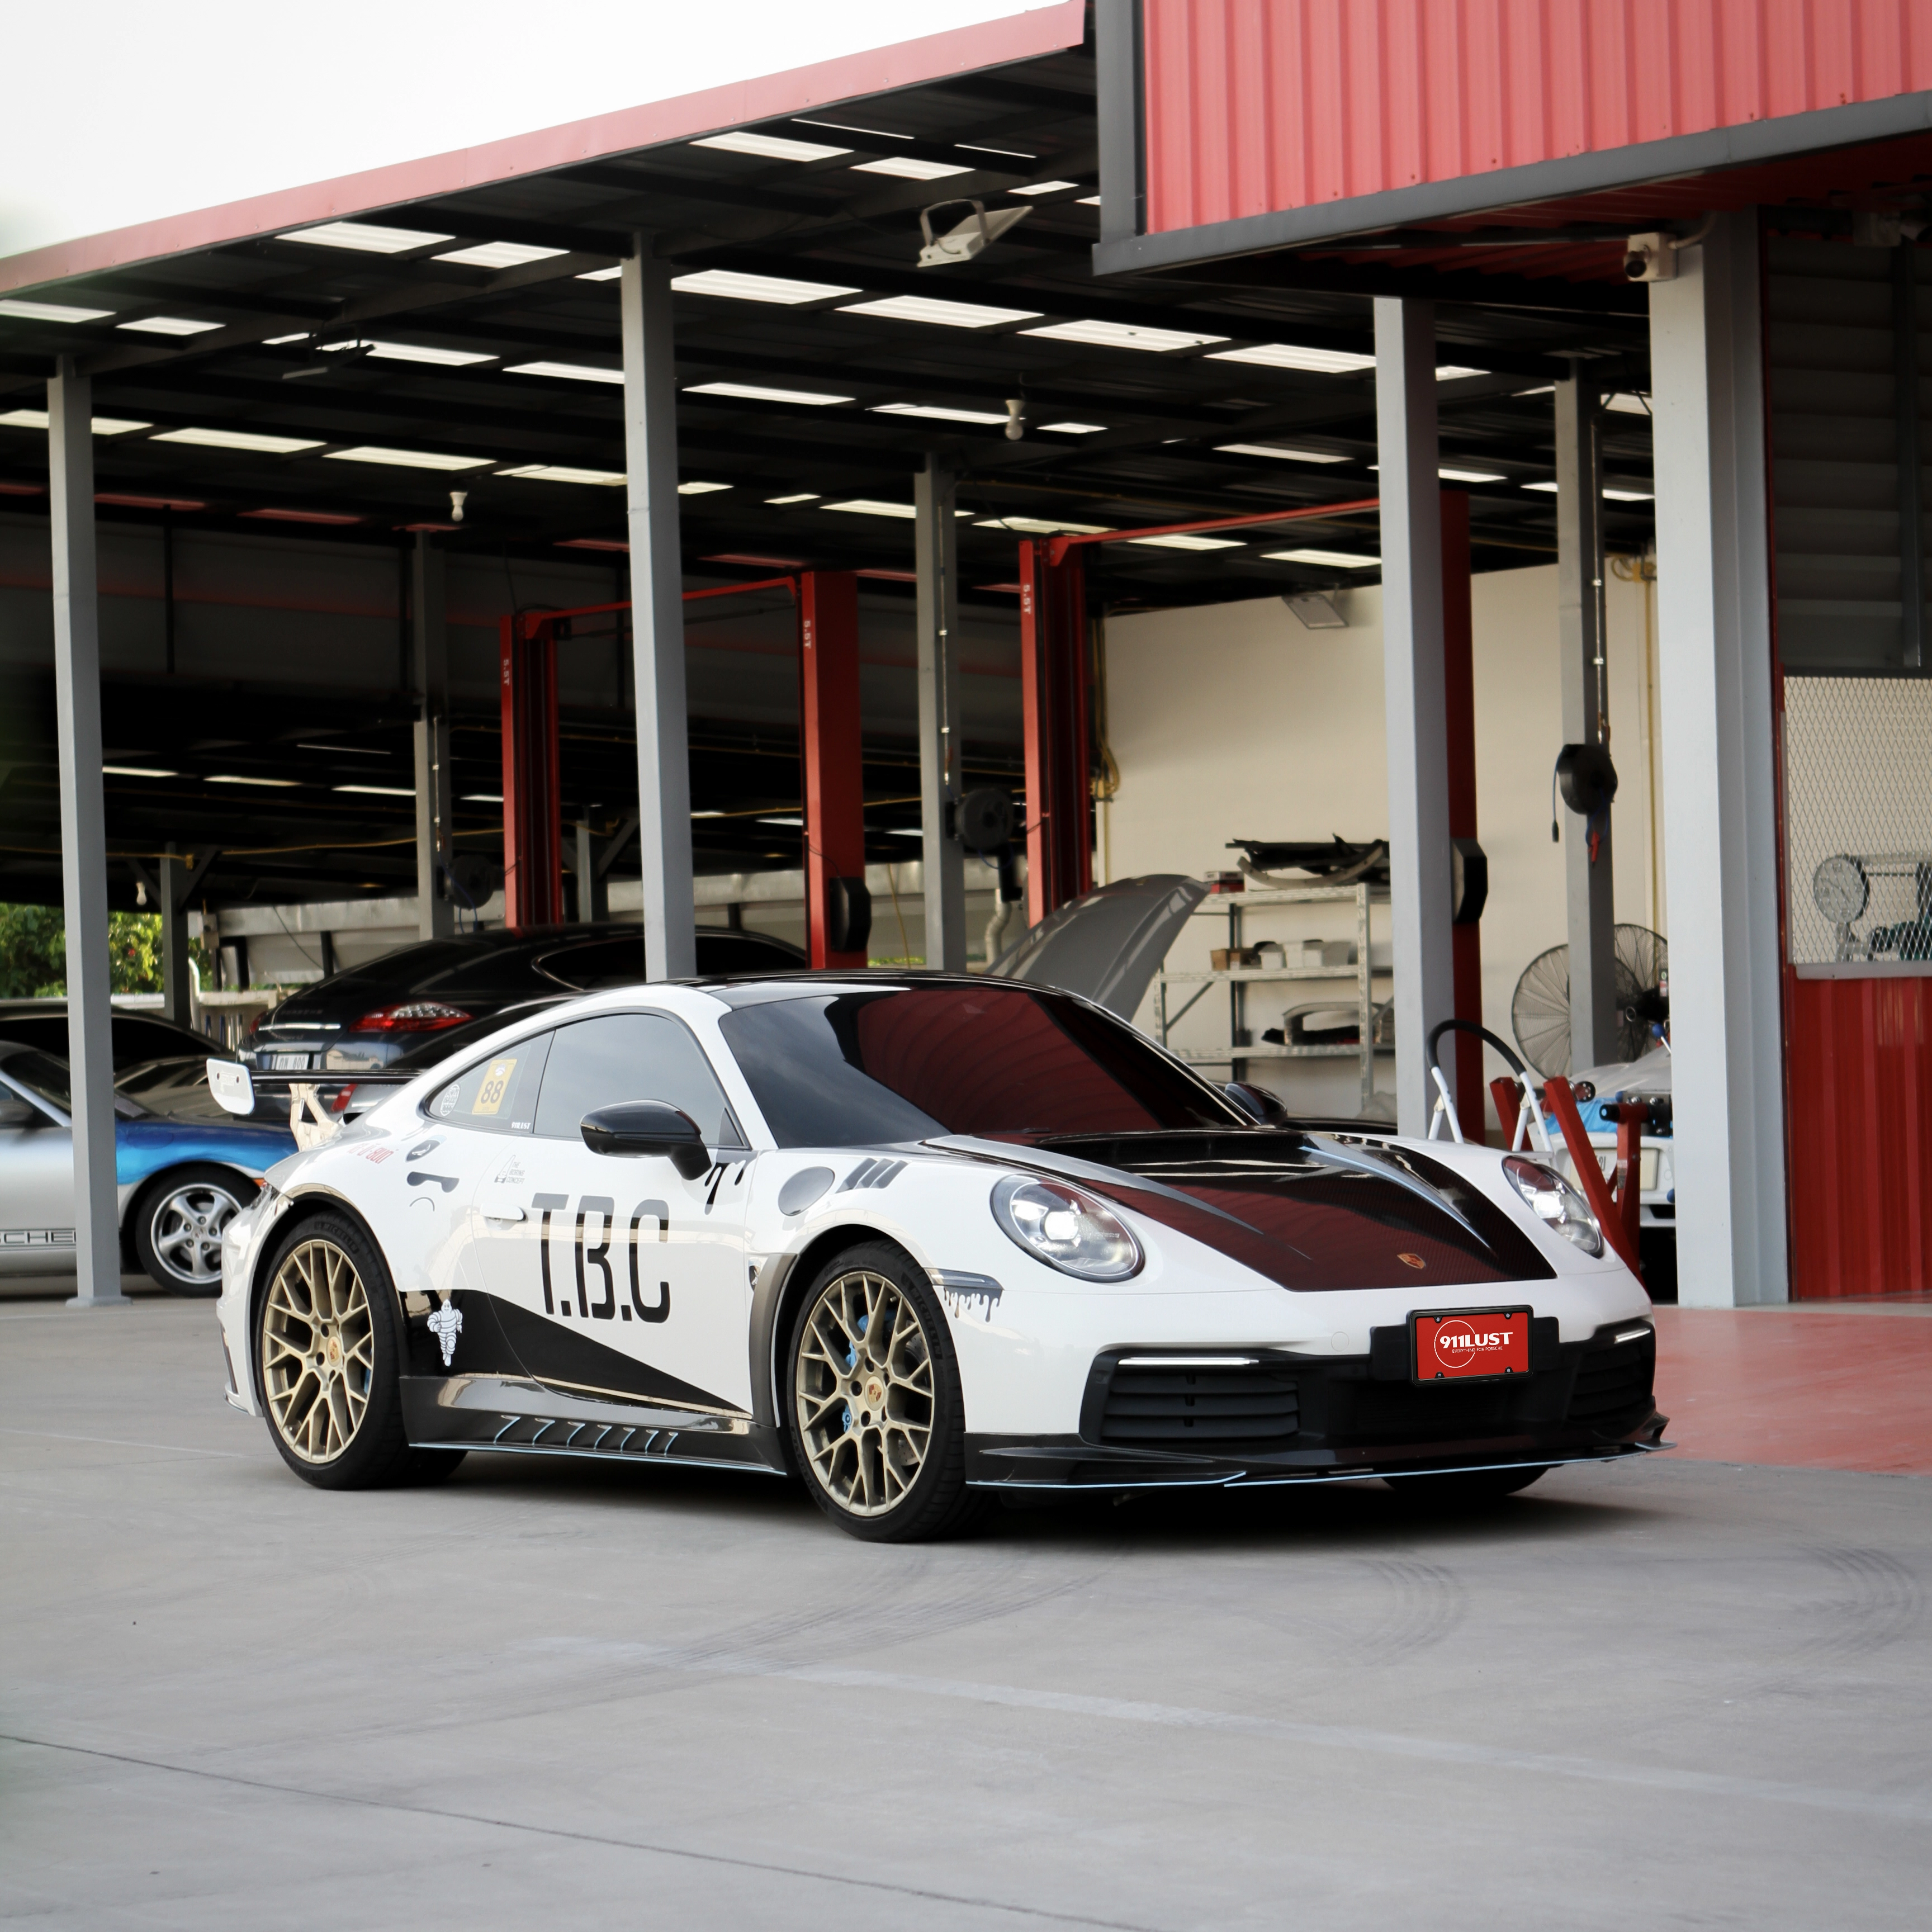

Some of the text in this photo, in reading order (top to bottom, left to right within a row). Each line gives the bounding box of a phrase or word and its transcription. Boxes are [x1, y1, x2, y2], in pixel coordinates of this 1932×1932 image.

[481, 1080, 503, 1104] 88
[0, 1232, 73, 1244] CHE
[910, 1286, 943, 1357] MICHELIN
[1439, 1332, 1513, 1349] 911LUST
